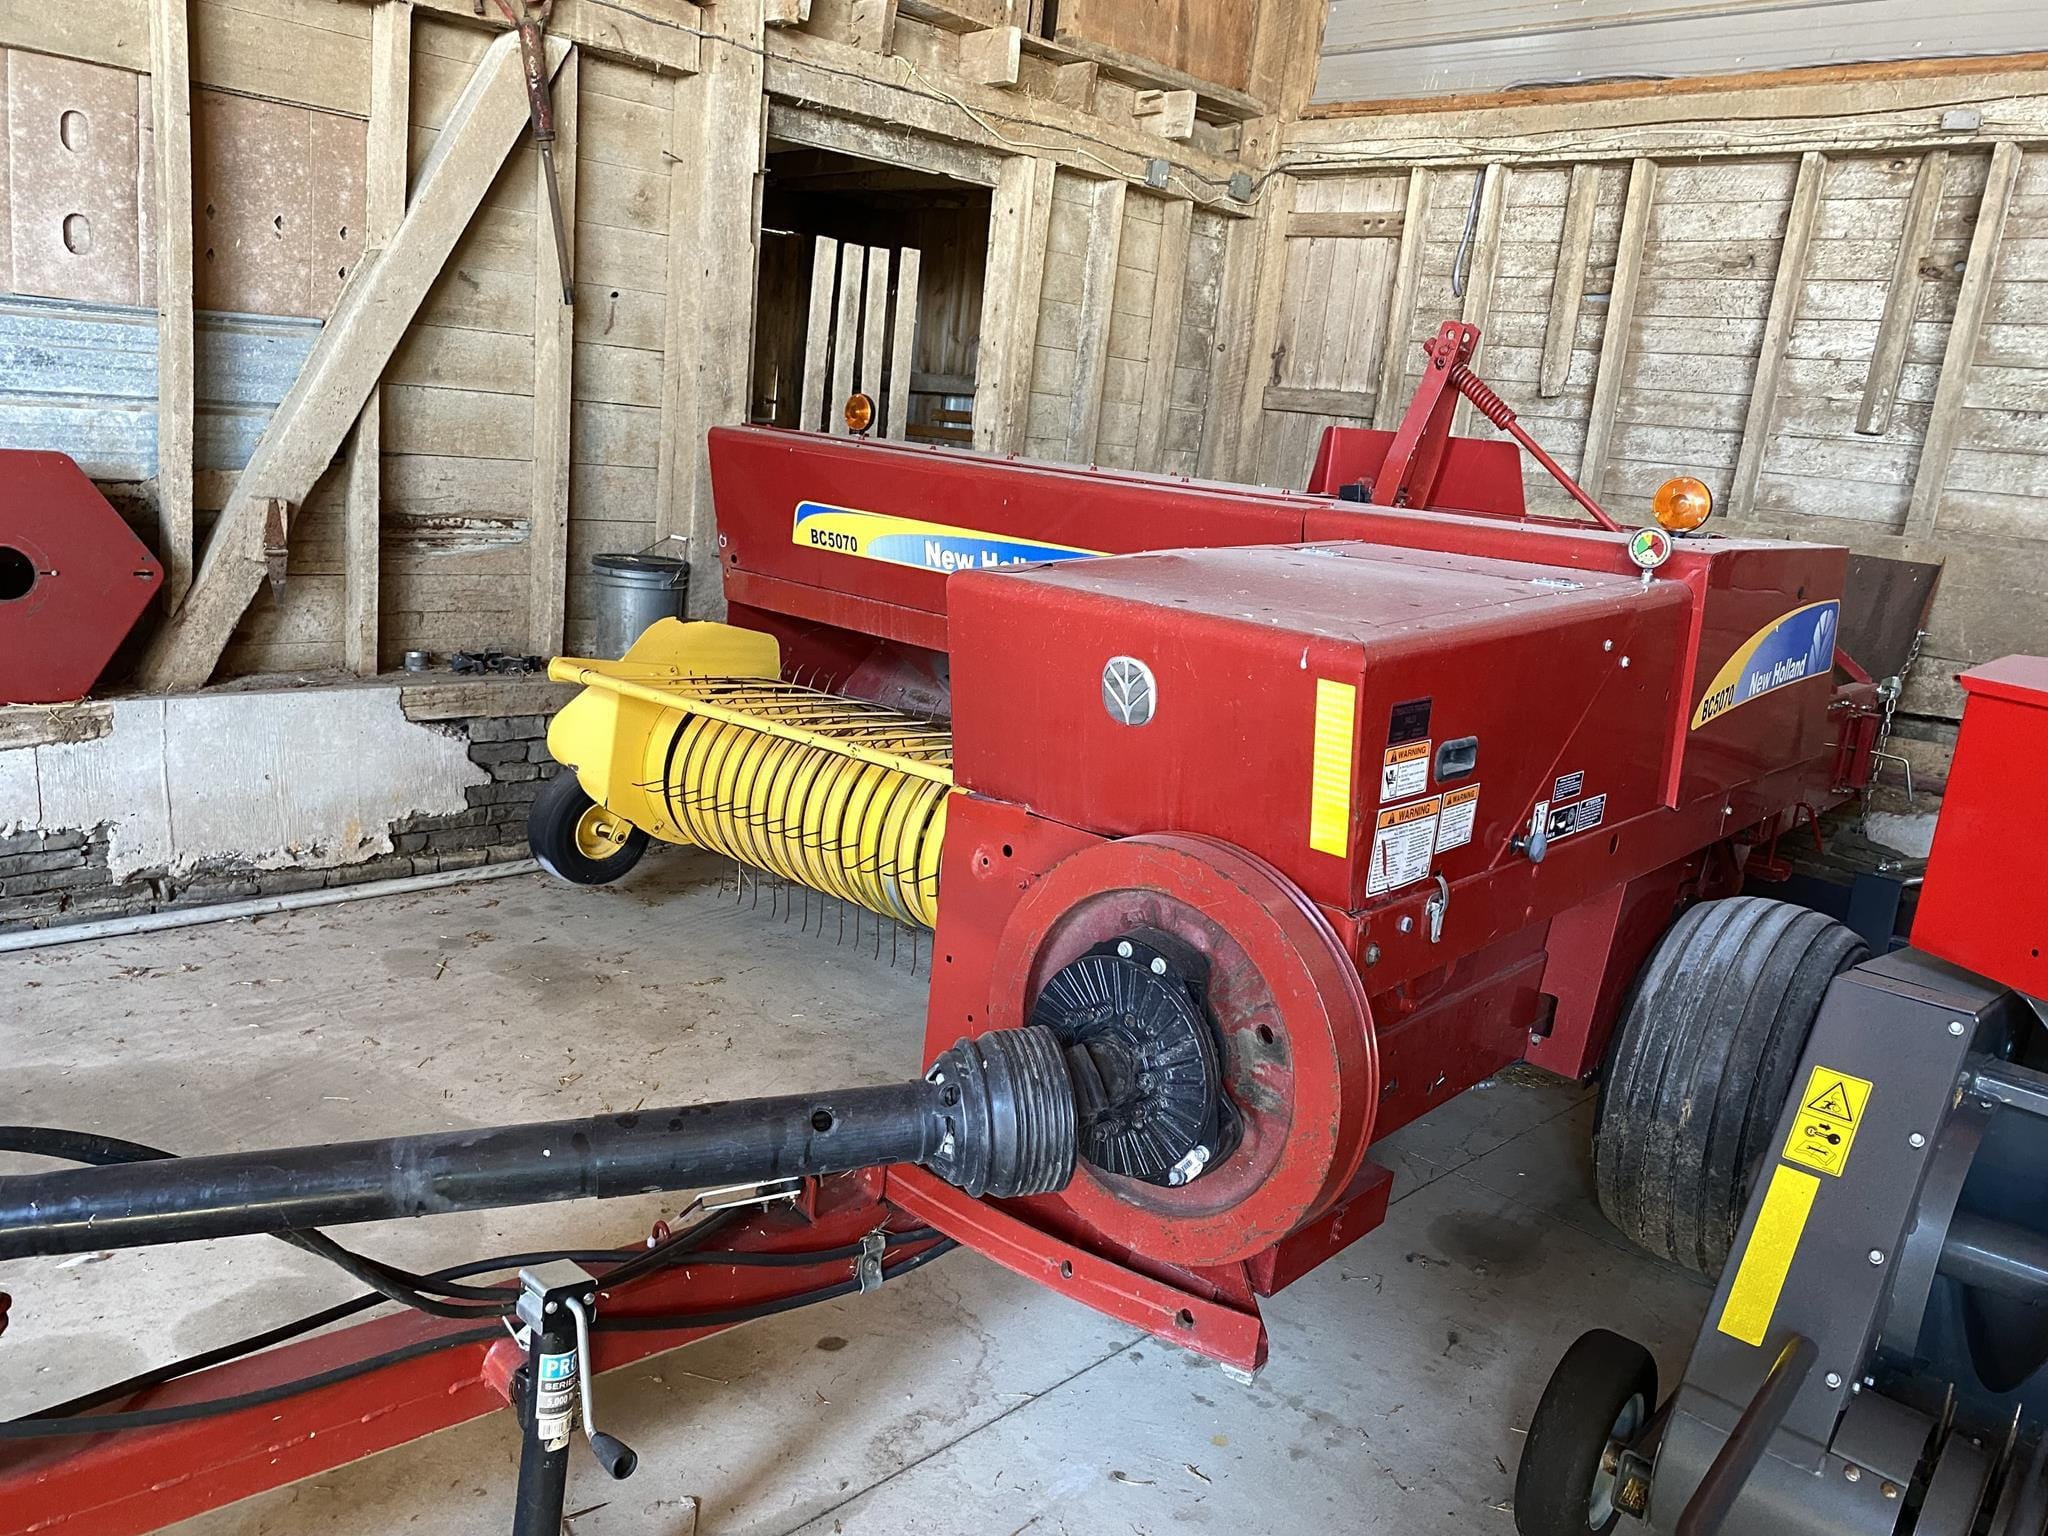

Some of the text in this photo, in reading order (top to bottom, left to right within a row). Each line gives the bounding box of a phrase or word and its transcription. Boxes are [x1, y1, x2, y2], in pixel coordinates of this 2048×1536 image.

[810, 529, 858, 552] BC5070
[924, 540, 974, 570] New
[1748, 653, 1808, 697] New Holland
[1701, 684, 1735, 721] BC5070
[1398, 746, 1426, 759] WARNING
[1452, 790, 1475, 802] WARNING
[1398, 804, 1430, 821] WARNING
[545, 1354, 577, 1377] PRO
